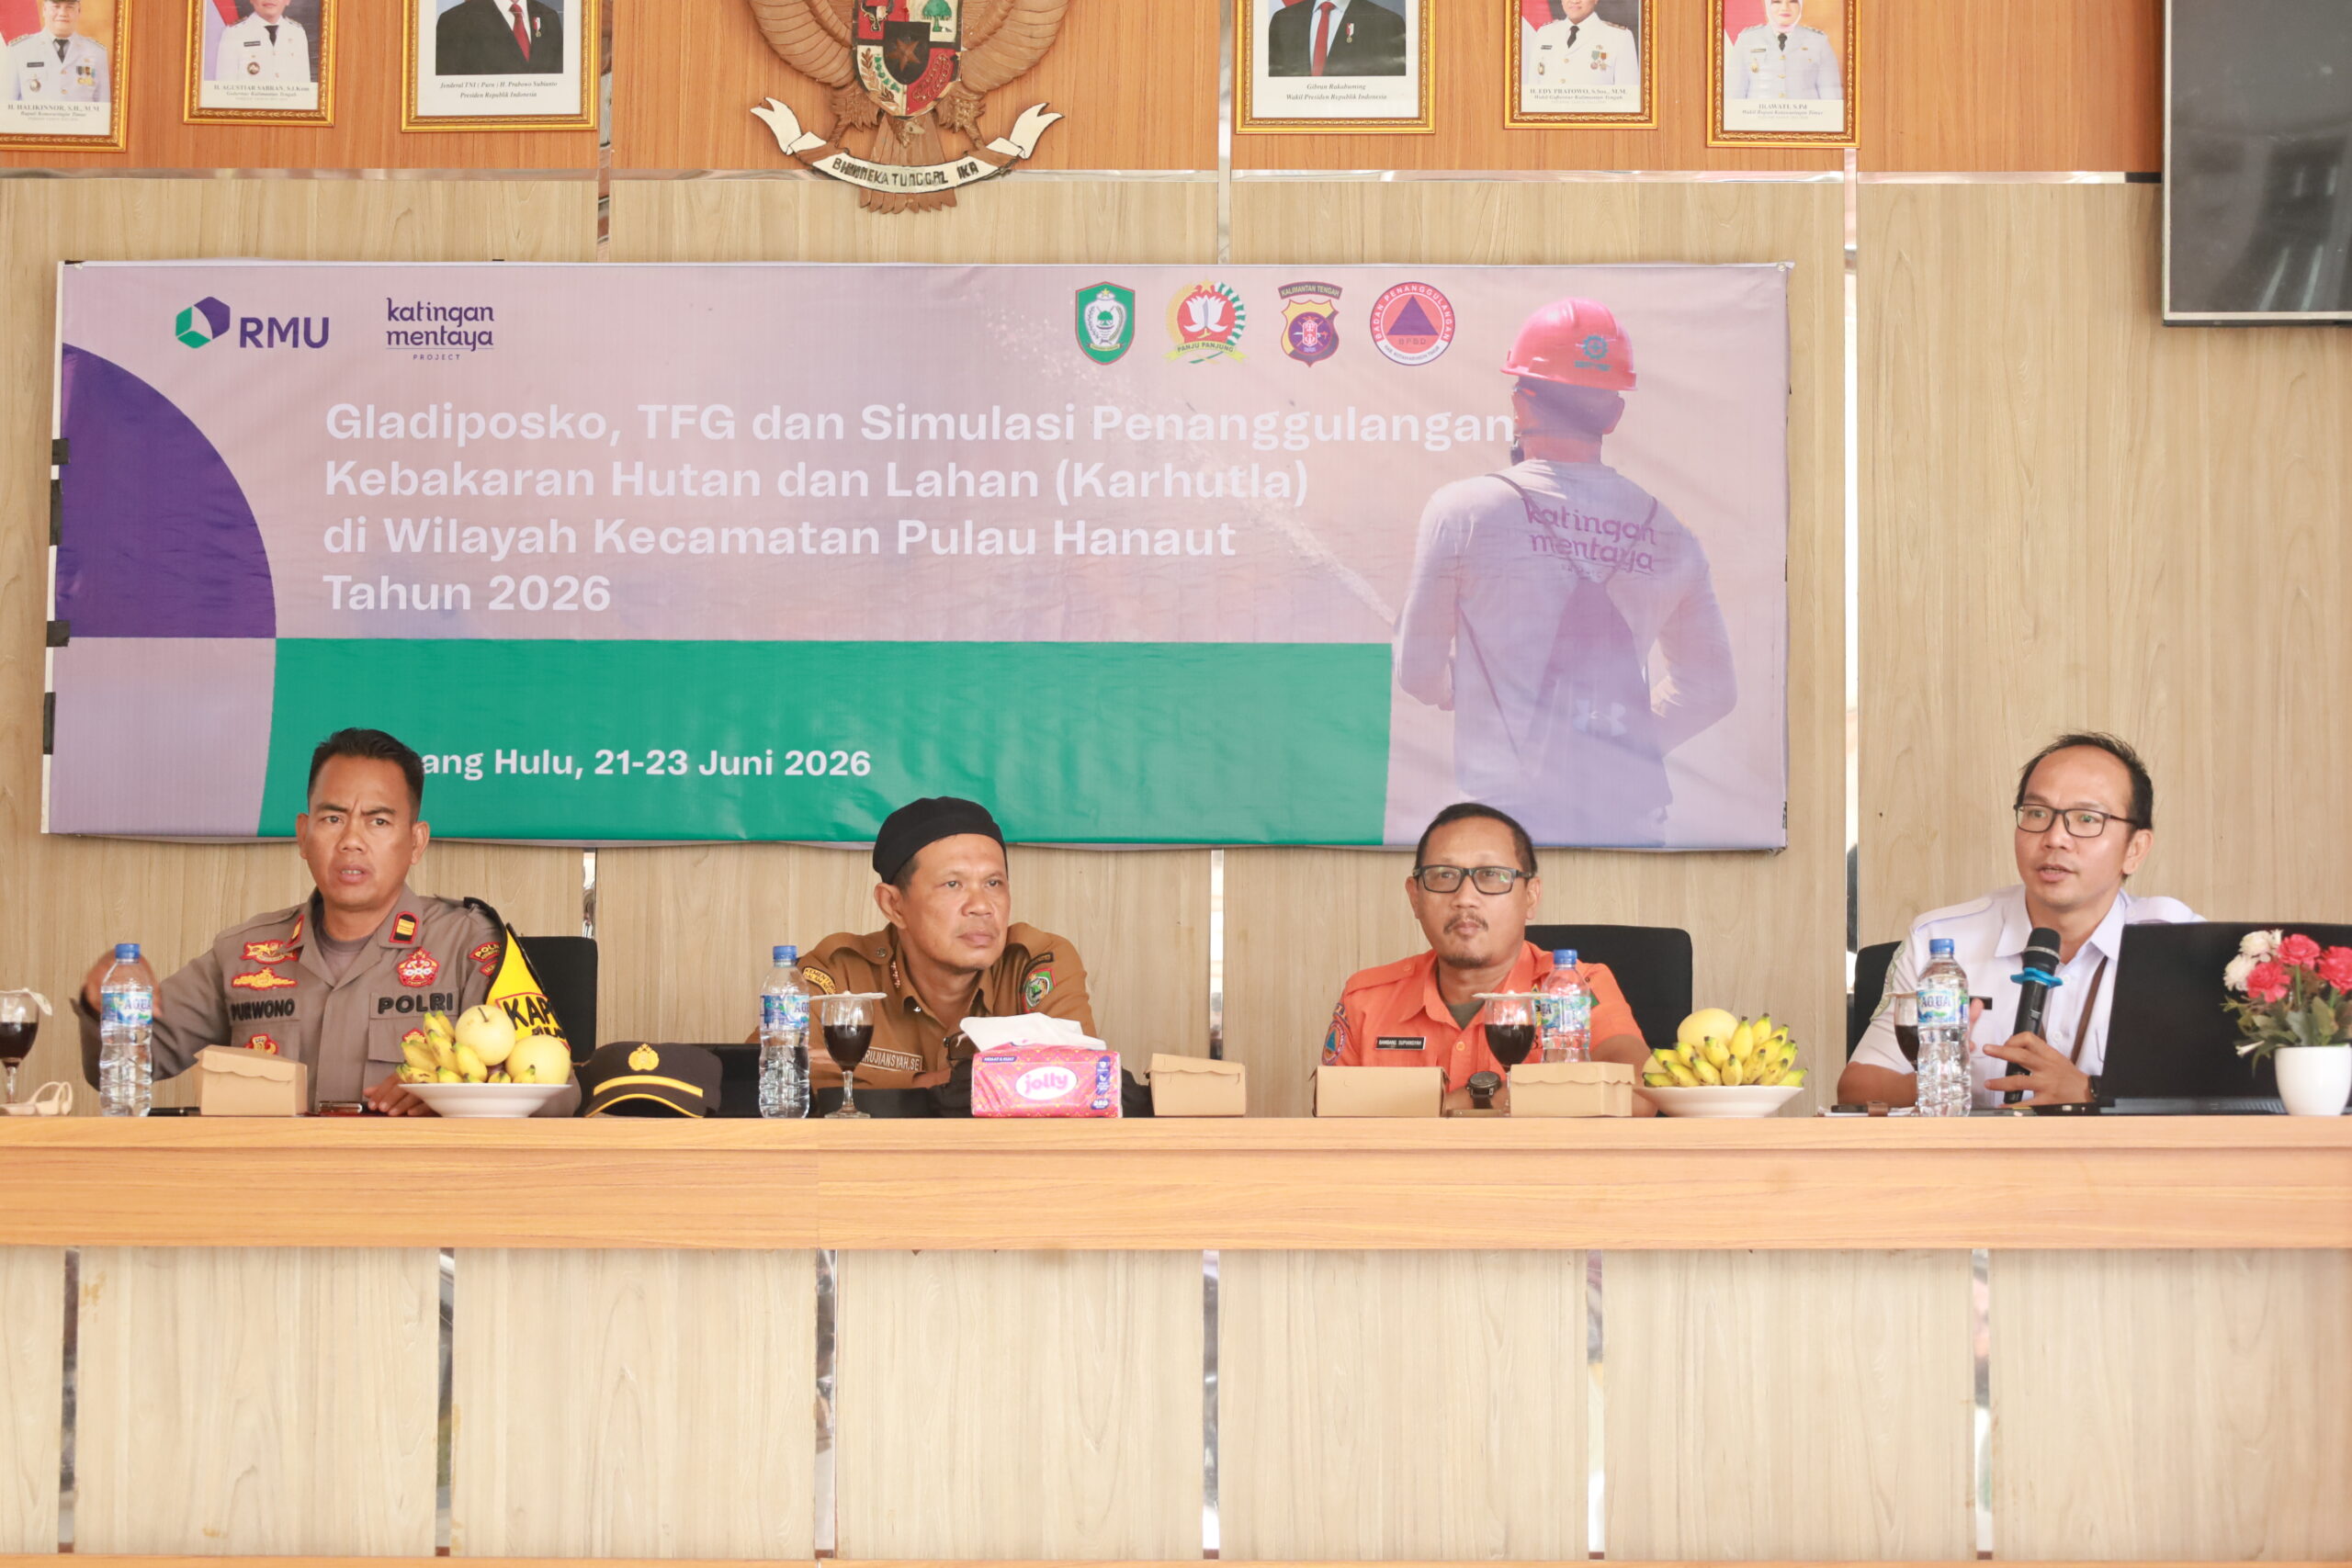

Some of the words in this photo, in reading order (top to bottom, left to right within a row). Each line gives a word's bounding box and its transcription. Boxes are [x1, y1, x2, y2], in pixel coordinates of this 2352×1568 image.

[956, 161, 979, 180] IKA
[1281, 285, 1317, 296] KALIMANTAN
[1317, 285, 1340, 297] TENGAH
[386, 297, 494, 328] katingan
[1373, 304, 1385, 339] BADAN
[1384, 285, 1453, 339] PENANGGULANGAN
[239, 316, 330, 349] RMU
[386, 324, 494, 352] mentaya
[413, 353, 461, 361] PROJECT
[1177, 343, 1200, 353] PANJU
[1201, 343, 1234, 353] PANJUNG
[326, 402, 622, 449] Gladiposko,
[638, 404, 737, 441] TFG
[752, 405, 845, 441] dan
[861, 403, 1075, 442] Simulasi
[1093, 406, 1515, 451] Penanggulangan
[325, 461, 595, 497] Kebakaran
[612, 461, 762, 498] Hutan
[777, 462, 870, 498] dan
[887, 462, 1039, 498] Lahan
[1056, 459, 1308, 508] (Karhutla)
[1524, 499, 1657, 545] katingan
[323, 516, 368, 553] di
[383, 516, 578, 563] Wilayah
[594, 519, 881, 555] Kecamatan
[897, 520, 1037, 556] Pulau
[1054, 520, 1238, 557] Hanaut
[1530, 534, 1655, 572] mentaya
[322, 575, 472, 612] Tahun
[488, 575, 612, 613] 2026
[421, 752, 484, 781] ang
[494, 750, 584, 781] Hulu,
[594, 750, 689, 775] 21-23
[698, 750, 775, 776] Juni
[784, 750, 872, 777] 2026
[230, 998, 296, 1021] PURWONO
[378, 992, 454, 1015] POLRI
[1921, 996, 1952, 1009] AQUA
[863, 1050, 921, 1071] RUJIANSYAH,SE
[1024, 1072, 1068, 1095] jolly
